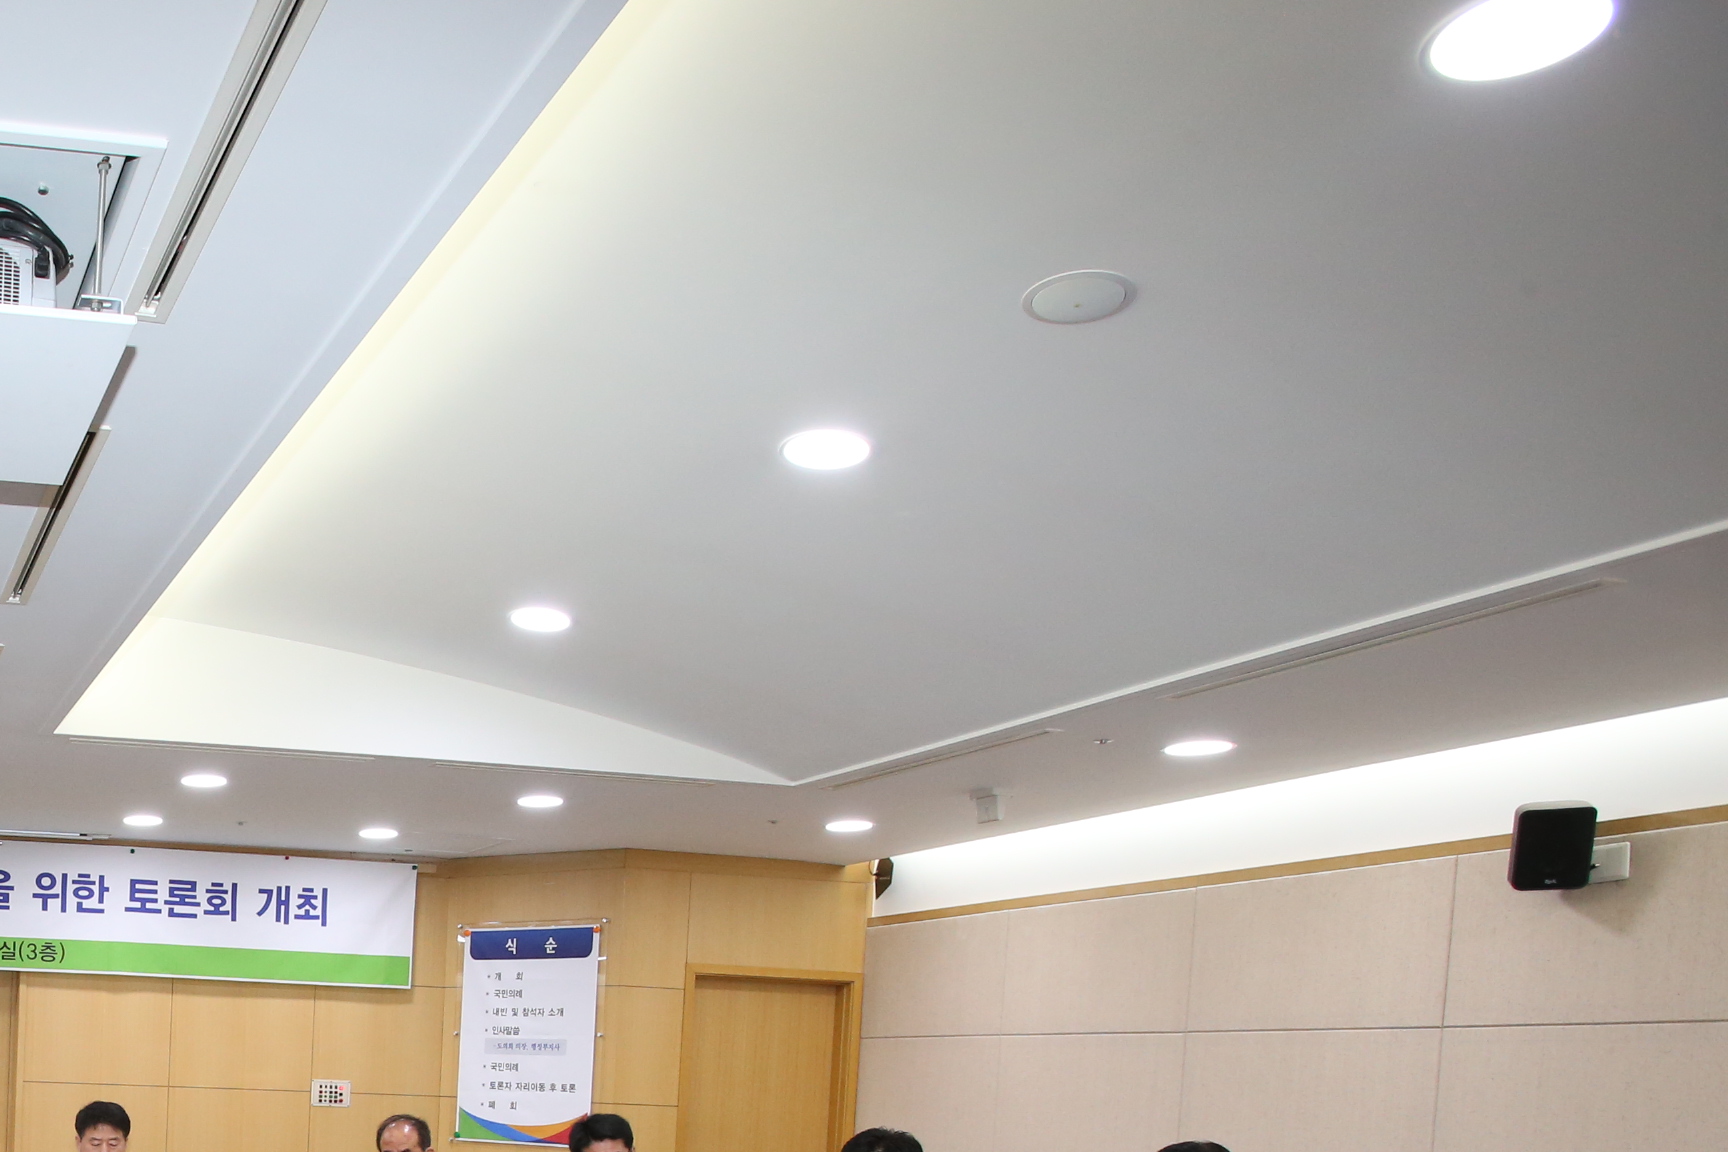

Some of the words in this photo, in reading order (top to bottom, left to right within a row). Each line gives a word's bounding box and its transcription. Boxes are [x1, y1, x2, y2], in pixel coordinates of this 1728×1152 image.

[31, 871, 109, 914] 위한
[124, 877, 238, 922] 토론회
[256, 883, 329, 928] 개최
[505, 937, 517, 955] 식
[544, 936, 558, 954] 순
[493, 989, 523, 999] 국민의례
[492, 1007, 508, 1017] 내빈
[511, 1007, 519, 1017] 및
[522, 1007, 545, 1017] 참석자
[548, 1007, 564, 1017] 소개
[492, 1025, 520, 1036] 인사말씀
[490, 1062, 519, 1072] 국민의례
[489, 1081, 512, 1091] 토론자
[515, 1081, 546, 1093] 자리이동
[549, 1082, 557, 1092] 후
[560, 1083, 577, 1094] 토론
